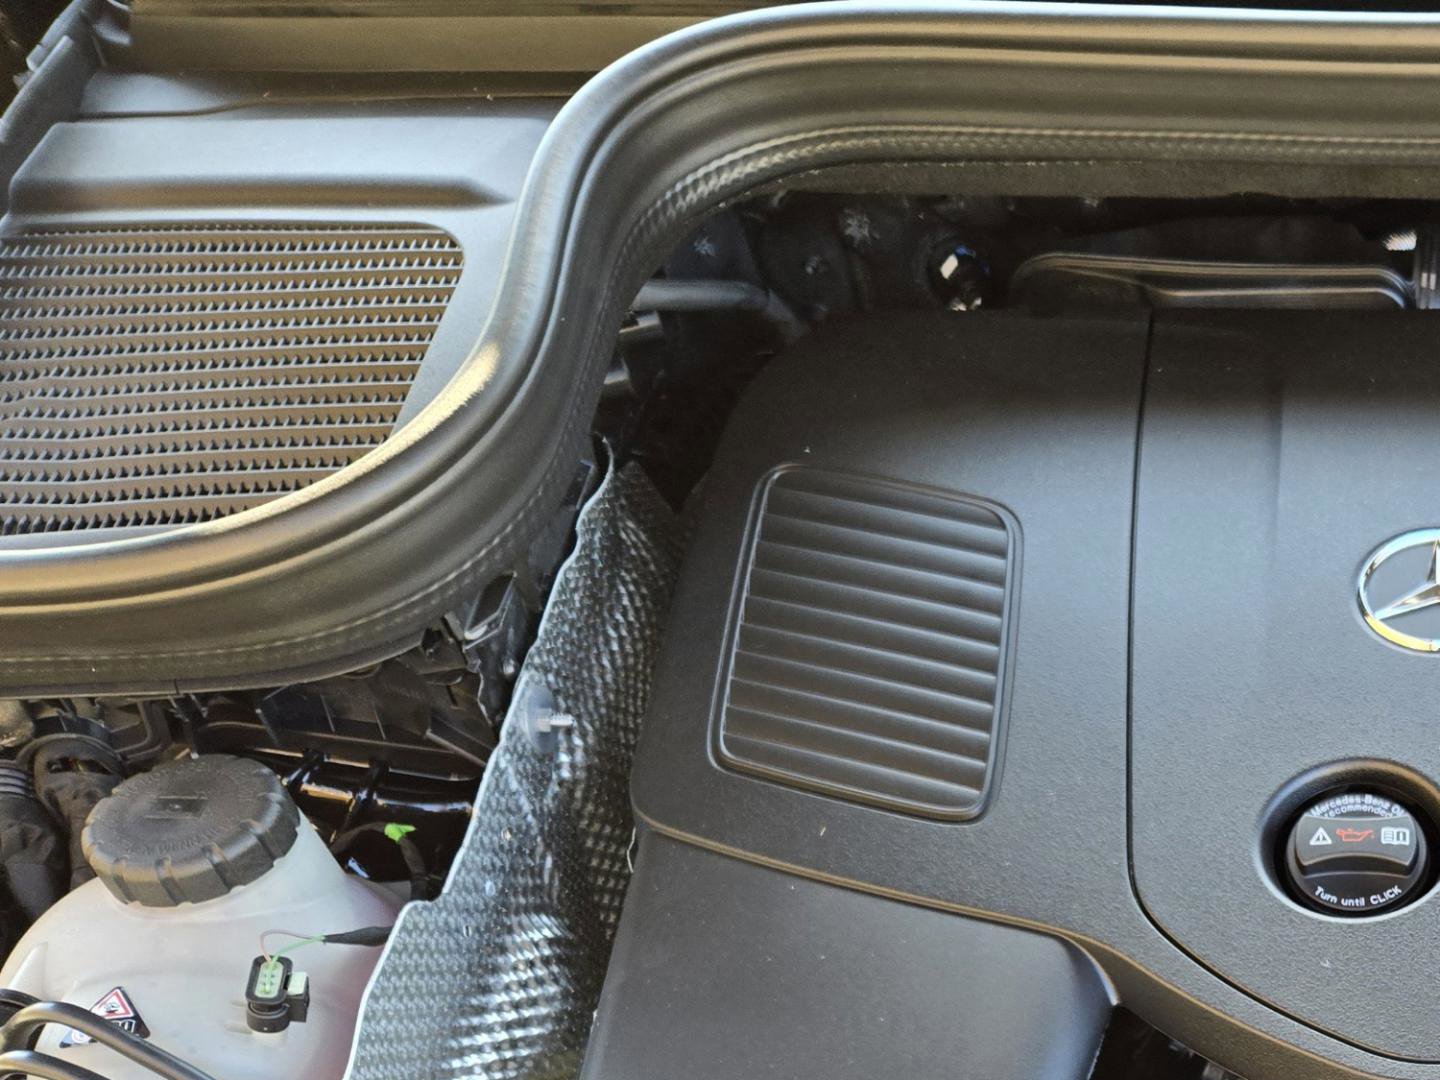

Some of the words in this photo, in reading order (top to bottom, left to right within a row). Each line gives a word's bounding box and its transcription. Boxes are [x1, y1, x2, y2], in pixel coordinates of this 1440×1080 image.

[1311, 794, 1391, 816] Mercedes-Benz
[1324, 804, 1393, 818] recommended
[1315, 886, 1338, 905] Turn
[1341, 896, 1366, 908] until
[1370, 884, 1403, 905] CLICK
